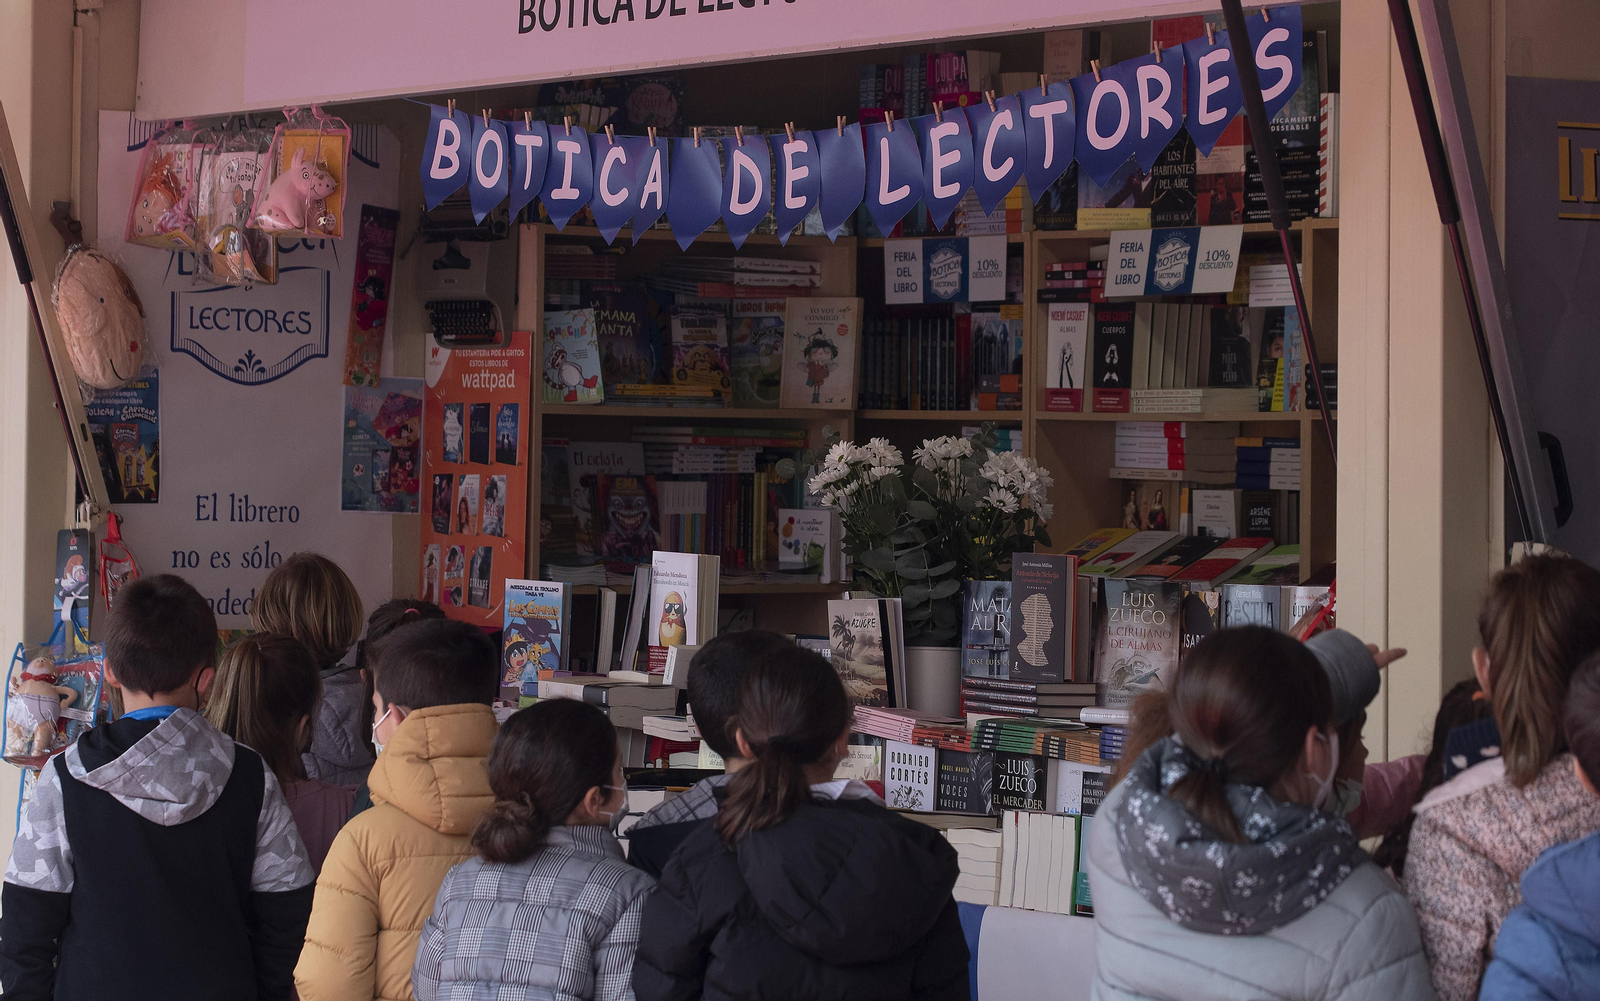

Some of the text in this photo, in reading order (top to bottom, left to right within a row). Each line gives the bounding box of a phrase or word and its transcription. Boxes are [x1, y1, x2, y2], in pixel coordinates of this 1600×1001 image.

[935, 56, 968, 83] CULPA
[429, 27, 1294, 216] BOTICA DE LECTORES
[1272, 115, 1317, 124] TICAMENTE
[1270, 123, 1310, 132] DESEABLE
[1168, 151, 1181, 162] LOS
[1153, 164, 1195, 176] HABITANTES
[1159, 178, 1189, 189] DEL AIRE
[1119, 242, 1144, 253] FERIA
[893, 251, 918, 262] FERIA
[1157, 250, 1187, 268] BOTICA
[1204, 249, 1231, 261] 10%
[932, 260, 960, 277] BOTICA
[976, 259, 999, 271] 10%
[1120, 258, 1136, 269] DEL
[1198, 260, 1234, 270] DESCUENTO
[896, 267, 913, 277] DEL
[972, 270, 1003, 279] DESCUENTO
[1114, 273, 1141, 286] LIBRO
[893, 282, 918, 293] LIBRO
[804, 306, 836, 315] YO VOY
[1066, 309, 1087, 321] CASQUET
[189, 307, 313, 335] LECTORES
[804, 314, 840, 322] CONMIGO
[599, 323, 633, 337] ANTA
[1102, 325, 1127, 334] CUERPOS
[455, 349, 462, 357] TU
[491, 349, 502, 357] PIDE
[506, 349, 525, 357] GRITOS
[469, 359, 509, 368] ESTOS LIBROS DE
[461, 368, 516, 393] wattpad
[573, 450, 624, 467] El ciclista
[195, 492, 301, 524] El librero
[1251, 517, 1269, 526] LUPIN
[172, 540, 283, 570] no es sólo
[1121, 591, 1156, 608] LUIS
[1109, 606, 1166, 626] ZUECO
[970, 615, 993, 632] AL
[1116, 627, 1172, 640] CIRUJANO
[1110, 640, 1163, 653] DE ALMAS
[985, 658, 1001, 667] LUIS
[891, 751, 929, 768] RODRIGO
[1006, 758, 1031, 776] LUIS
[890, 767, 929, 786] CORTÉS
[998, 774, 1038, 794] ZUECO
[940, 783, 969, 798] VOCES
[1083, 788, 1107, 797] UNA HISTO
[939, 798, 967, 810] VUELVEN
[992, 794, 1044, 812] EL MERCADER
